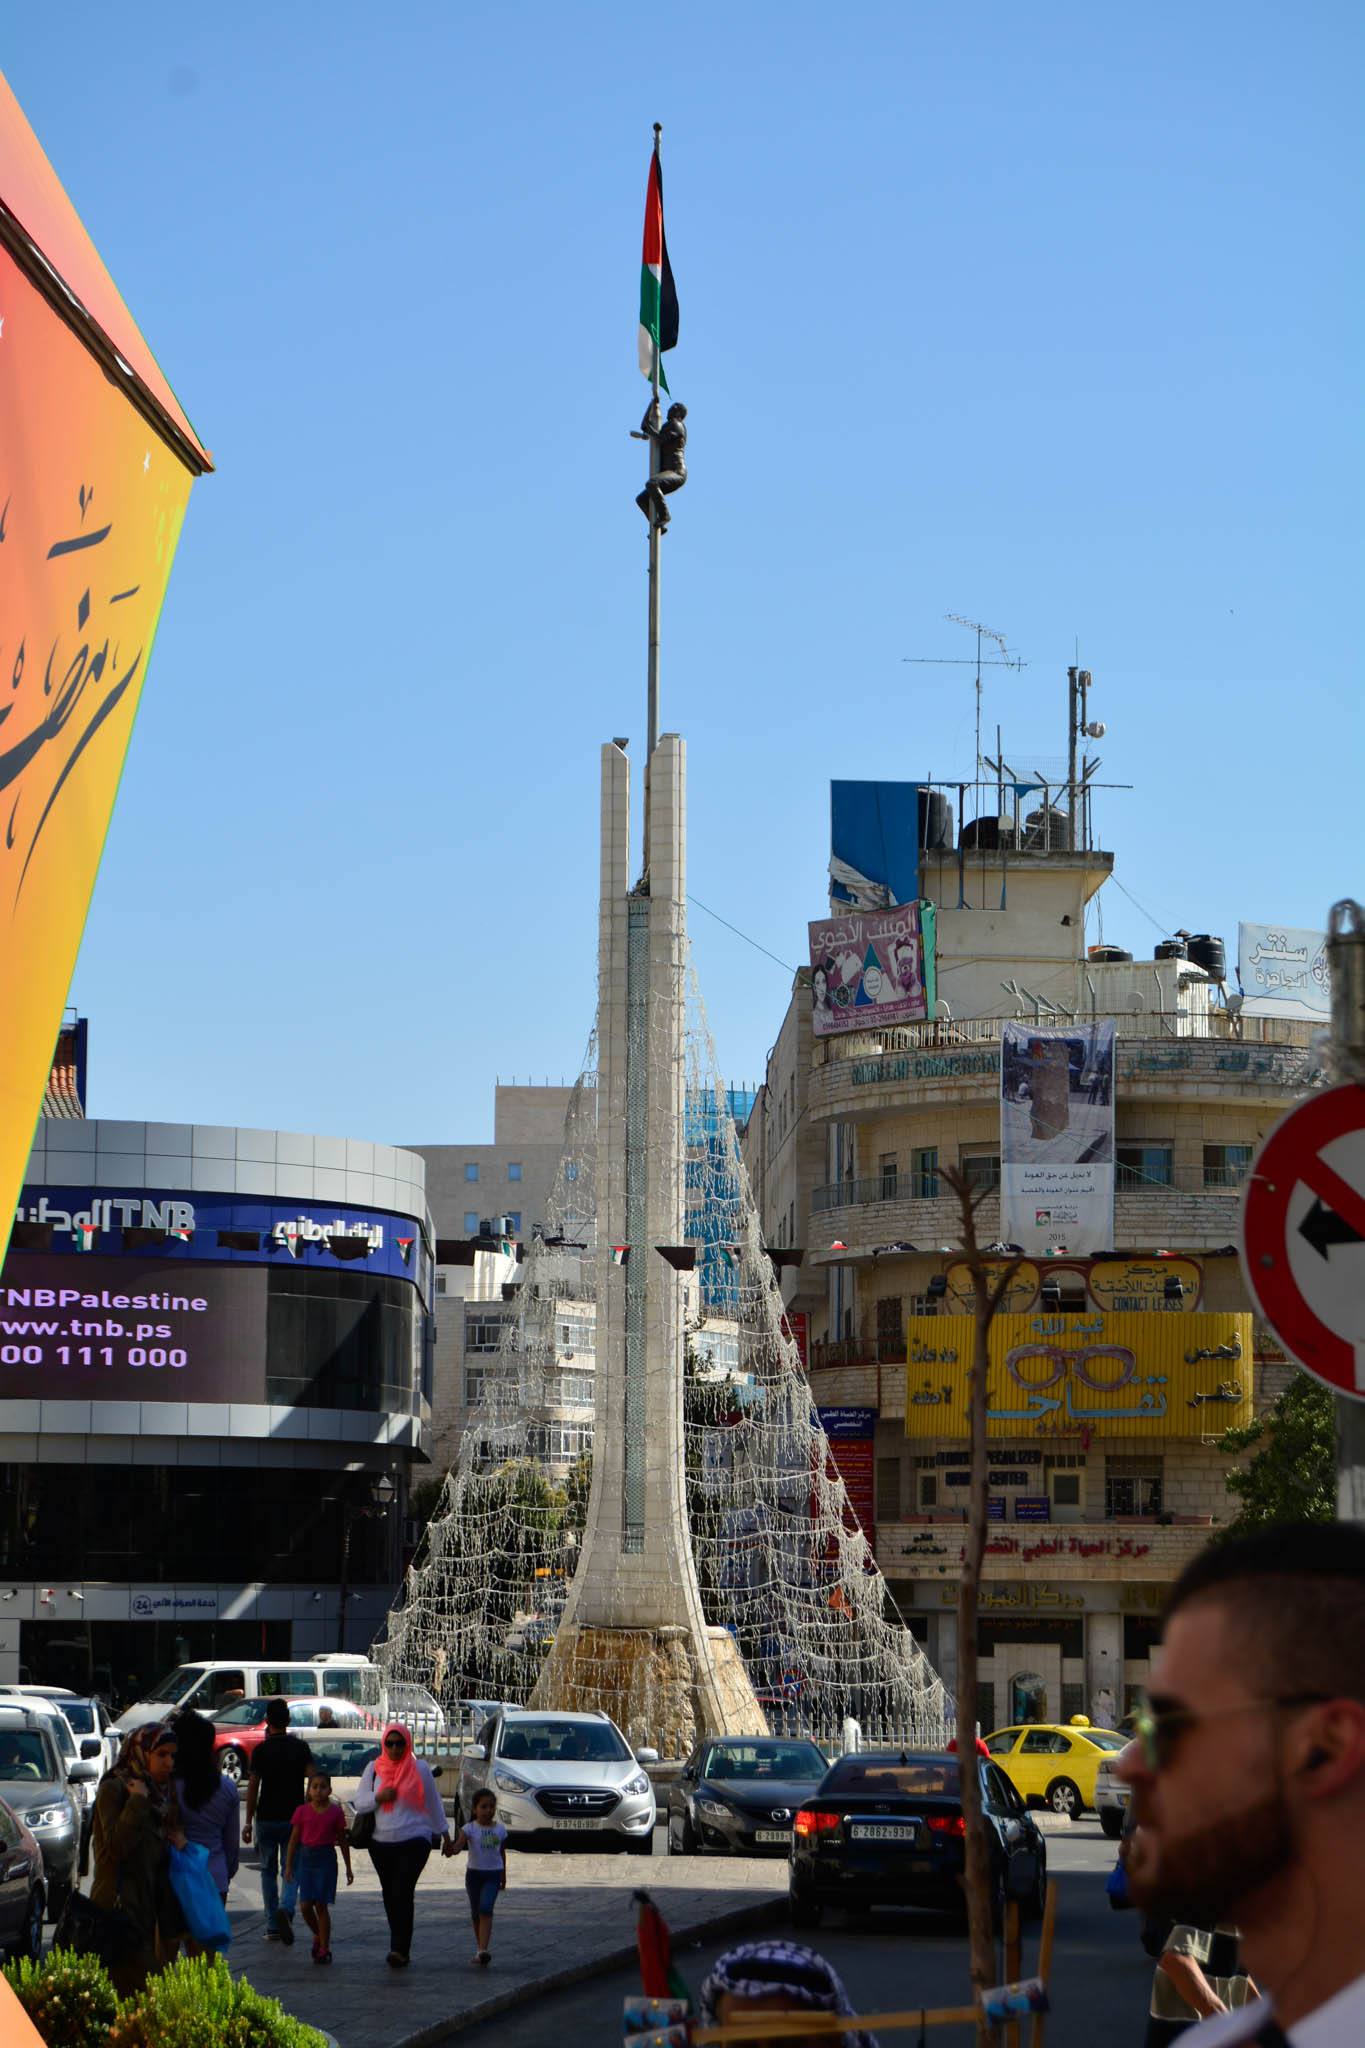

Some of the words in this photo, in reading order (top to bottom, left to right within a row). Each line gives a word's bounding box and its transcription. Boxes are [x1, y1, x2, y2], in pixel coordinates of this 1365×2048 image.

[1248, 934, 1308, 966] سنتر
[1115, 1050, 1193, 1079] التجار
[113, 1198, 196, 1236] TNB
[1048, 1233, 1066, 1241] 2015
[0, 1288, 208, 1311] NBPalestine
[1112, 1296, 1148, 1312] CONTACT
[0, 1320, 172, 1341] ww.tnb.ps
[1032, 1317, 1065, 1336] الله
[1070, 1318, 1104, 1342] عبد
[56, 1346, 113, 1366] 111
[128, 1348, 188, 1368] 000
[1023, 1538, 1062, 1562] الطبي
[1116, 1537, 1150, 1559] مركز
[1032, 1584, 1083, 1609] مركز
